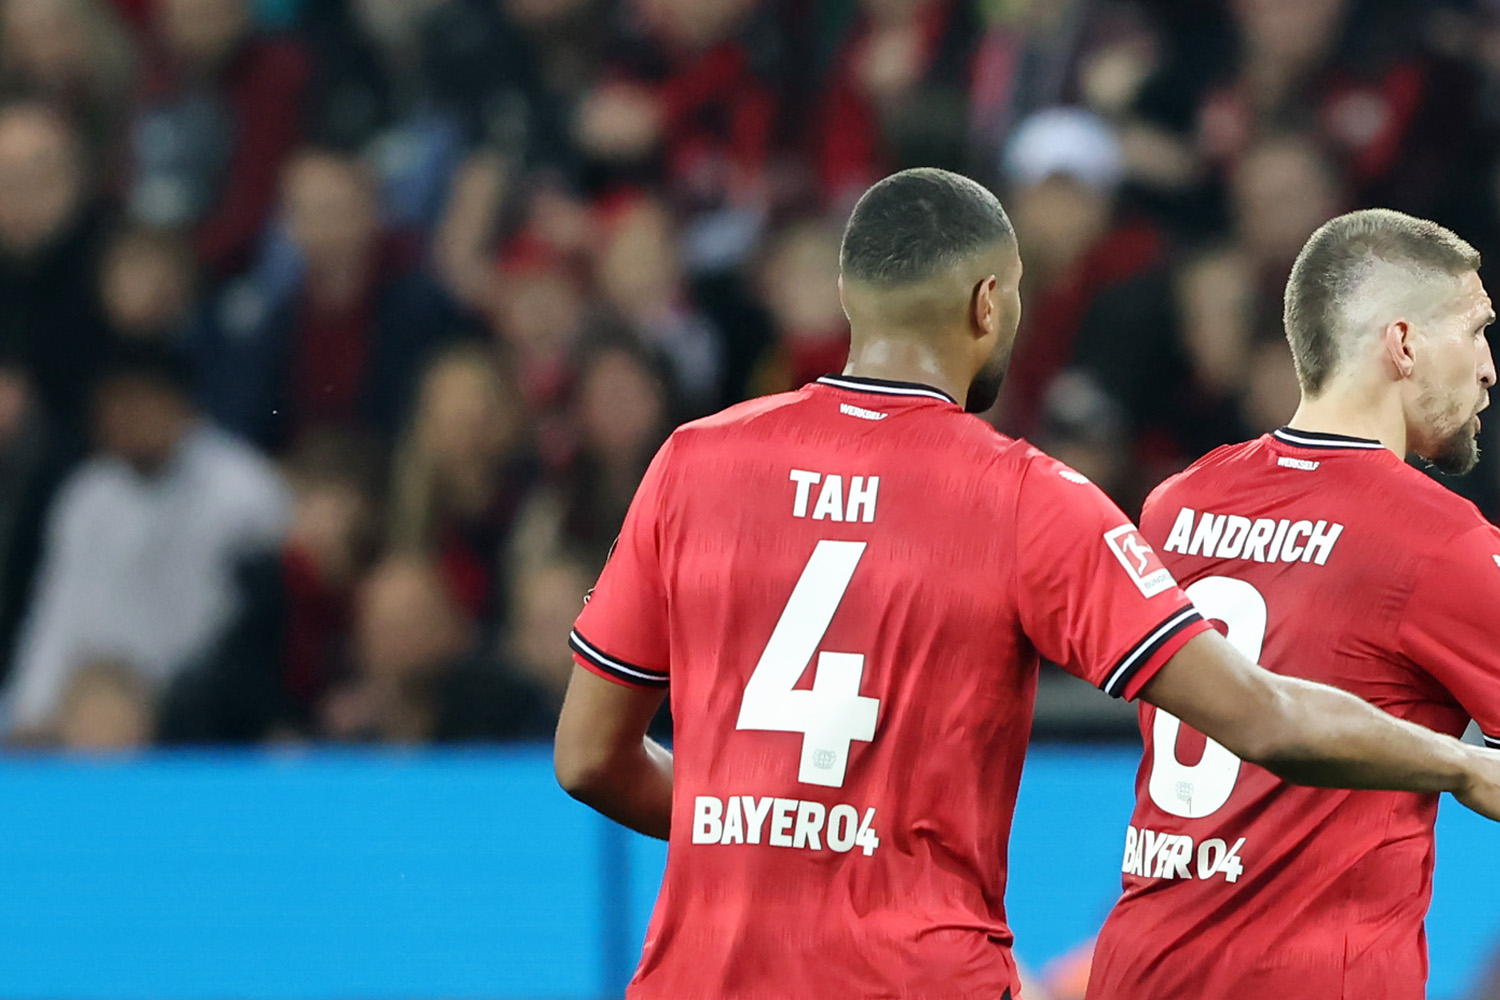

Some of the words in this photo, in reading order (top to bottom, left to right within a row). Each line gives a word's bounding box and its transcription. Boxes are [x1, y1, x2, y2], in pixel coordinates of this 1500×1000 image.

[1277, 456, 1320, 471] WERKSELF
[789, 469, 880, 522] TAH
[1163, 507, 1345, 566] ANDRICH
[736, 540, 880, 787] 4
